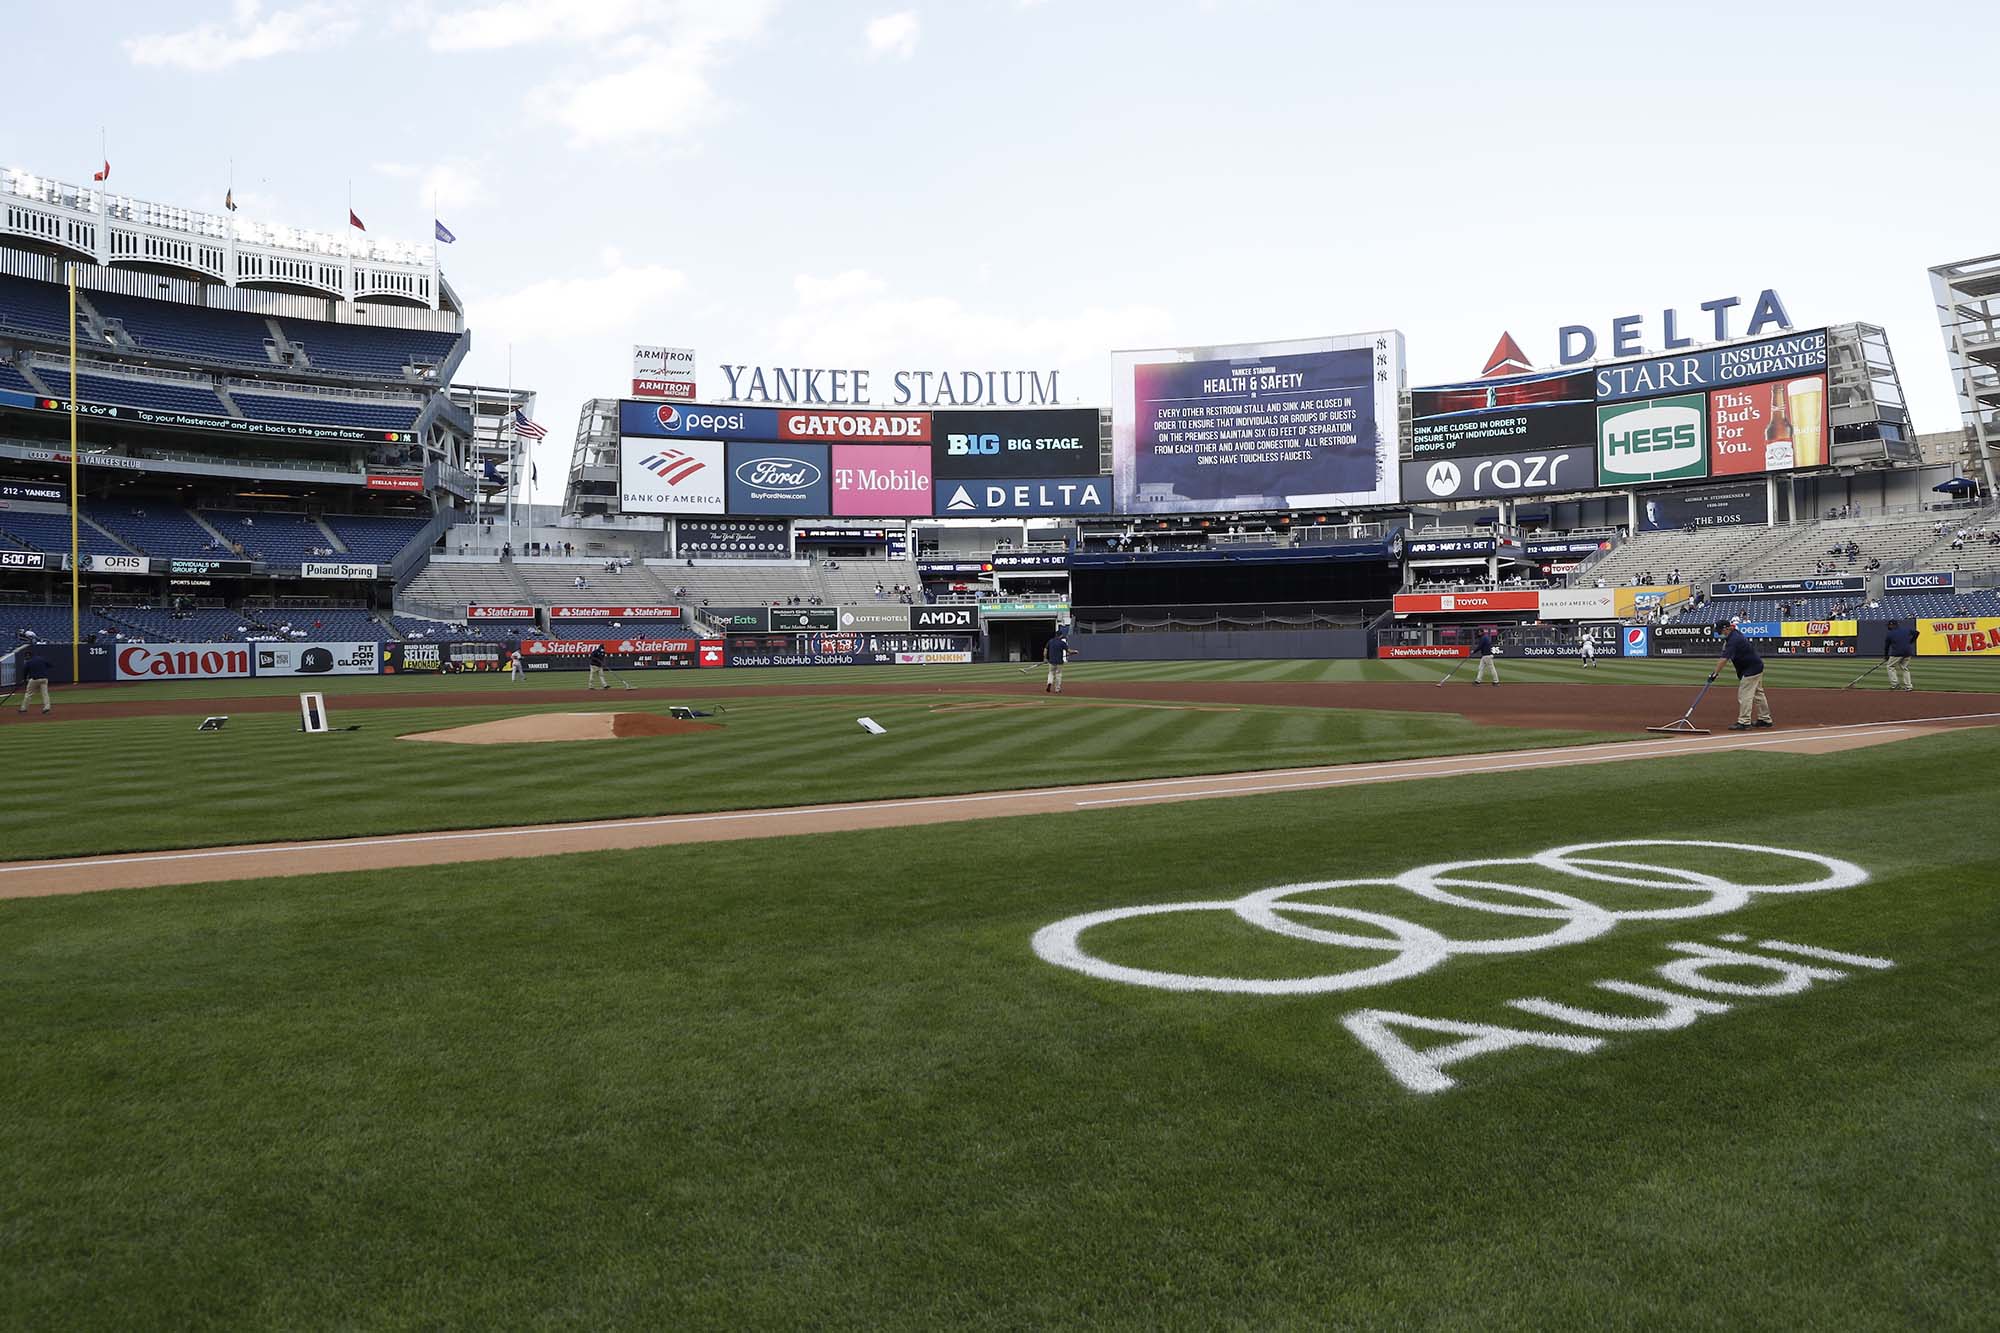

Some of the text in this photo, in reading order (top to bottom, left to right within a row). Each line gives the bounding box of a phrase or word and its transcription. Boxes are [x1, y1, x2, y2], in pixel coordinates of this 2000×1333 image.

[1559, 289, 1793, 365] DELTA
[636, 350, 692, 361] ARMITRON
[1720, 335, 1826, 366] INSURANCE
[1232, 366, 1276, 376] YANKEE STADIUM
[1720, 350, 1826, 380] COMPANIES
[1204, 373, 1303, 393] HEALTH & SAFETY
[1597, 358, 1708, 397] STARR
[639, 382, 690, 392] ARMITRON
[720, 365, 1060, 406] YANKEE STADIUM
[1158, 397, 1352, 418] EVERY OTHER RESTROOM STALL AND SINK ARE CLOSED IN
[1715, 393, 1753, 410] This
[686, 412, 744, 432] pepsi
[1154, 409, 1356, 430] ORDER TO ENSURE THAT INDIVIDUALS OR GROUPS OF GUESTS
[1716, 406, 1760, 425] Bud's
[137, 410, 153, 421] Tap
[231, 422, 248, 430] and
[249, 424, 263, 432] get
[265, 425, 286, 433] back
[298, 427, 312, 435] the
[339, 430, 365, 438] faster.
[788, 415, 921, 436] GATORADE
[1414, 417, 1527, 435] SINK ARE CLOSED IN ORDER TO
[1159, 423, 1352, 443] ON THE PREMISES MAINTAIN SIX (6) FEET OF SEPARATION
[1414, 426, 1527, 443] ENSURE THAT INDIVIDUALS OR
[1609, 424, 1696, 456] HESS
[1716, 426, 1744, 440] For
[1008, 438, 1032, 450] BIG
[1035, 437, 1083, 450] STAGE.
[1154, 435, 1357, 454] FROM EACH OTHER AND AVOID CONGESTION. ALL RESTROOM
[1414, 441, 1456, 452] GROUPS OF
[1716, 440, 1752, 455] You.
[84, 455, 141, 468] YANKEES CLUB
[1197, 451, 1313, 465] SINKS HAVE TOUCHLESS FAUCETS.
[751, 462, 805, 485] Ford
[1473, 454, 1570, 491] razr
[857, 470, 928, 491] Mobile
[3, 487, 61, 498] 212 YANKEES
[624, 494, 722, 504] BANK OF AMERICA
[986, 484, 1101, 507] DELTA
[1695, 514, 1741, 524] THE BOSS
[1412, 544, 1426, 552] APR
[1473, 541, 1488, 549] DET
[28, 555, 41, 564] PM
[105, 556, 140, 567] ORIS
[307, 564, 373, 577] Poland Spring
[1890, 575, 1939, 586] UNTUCKit
[709, 615, 757, 624] Uber Eats
[918, 612, 956, 625] AMD
[1655, 626, 1711, 636] G GATORADE G
[1933, 622, 1976, 631] WHO BUT
[404, 649, 439, 660] SELTZER
[925, 654, 966, 662] DUNKIN'
[1524, 647, 1554, 655] StubHub
[118, 647, 248, 676] Canon
[338, 659, 374, 667] GLORY
[733, 655, 853, 666] StubHub StubHub StubHub
[1340, 933, 1896, 1095] Audi
